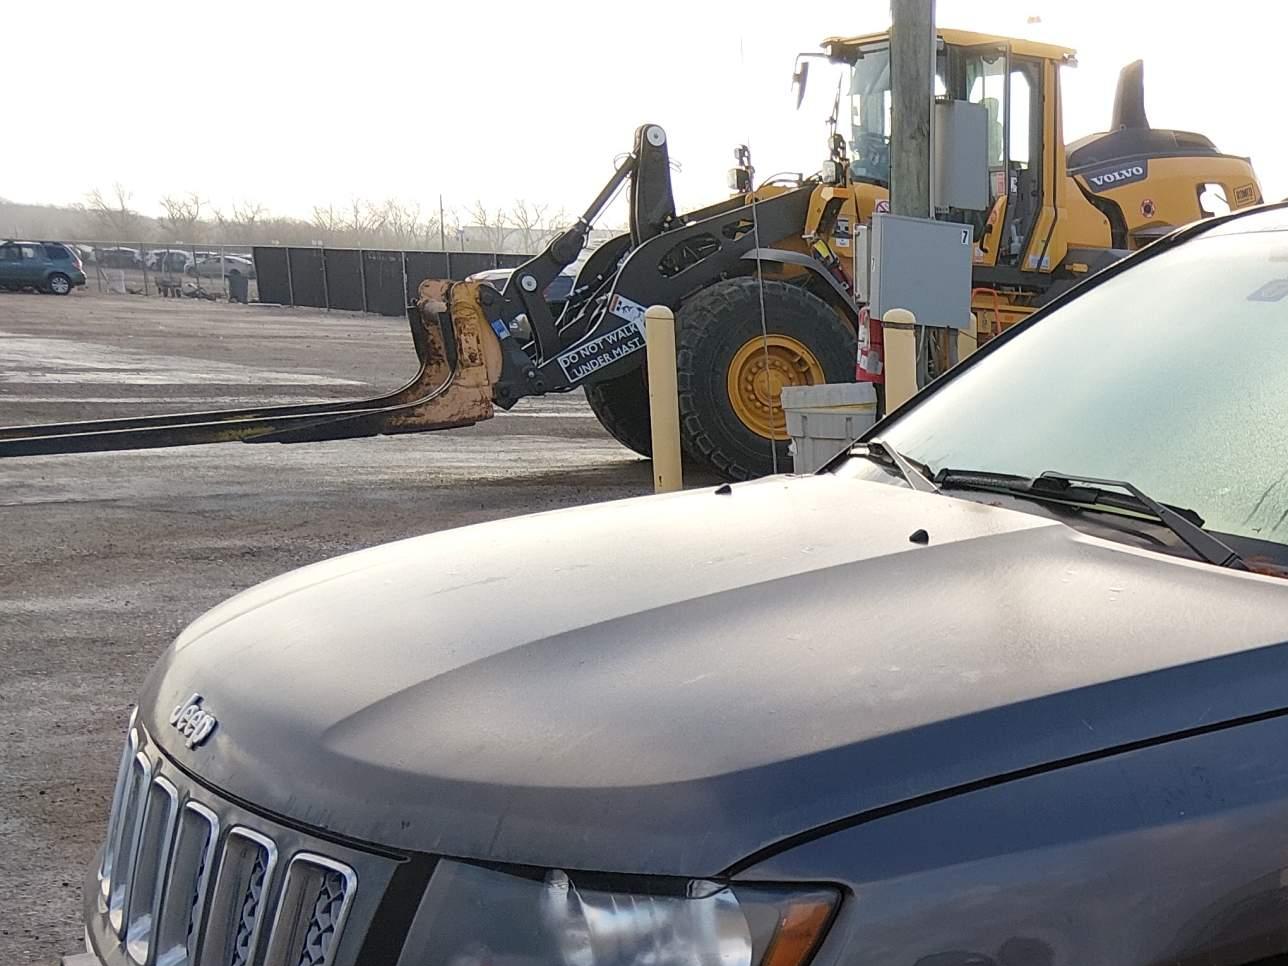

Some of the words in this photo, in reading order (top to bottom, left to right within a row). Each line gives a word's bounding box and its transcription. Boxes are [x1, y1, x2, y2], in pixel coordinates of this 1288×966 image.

[1091, 166, 1144, 186] VOLVO
[962, 230, 968, 244] 7
[561, 353, 579, 368] DO
[580, 339, 605, 358] NOT
[605, 324, 639, 345] WALK
[573, 352, 610, 377] UNDER
[612, 337, 641, 358] MAST
[169, 692, 216, 748] Jeep
